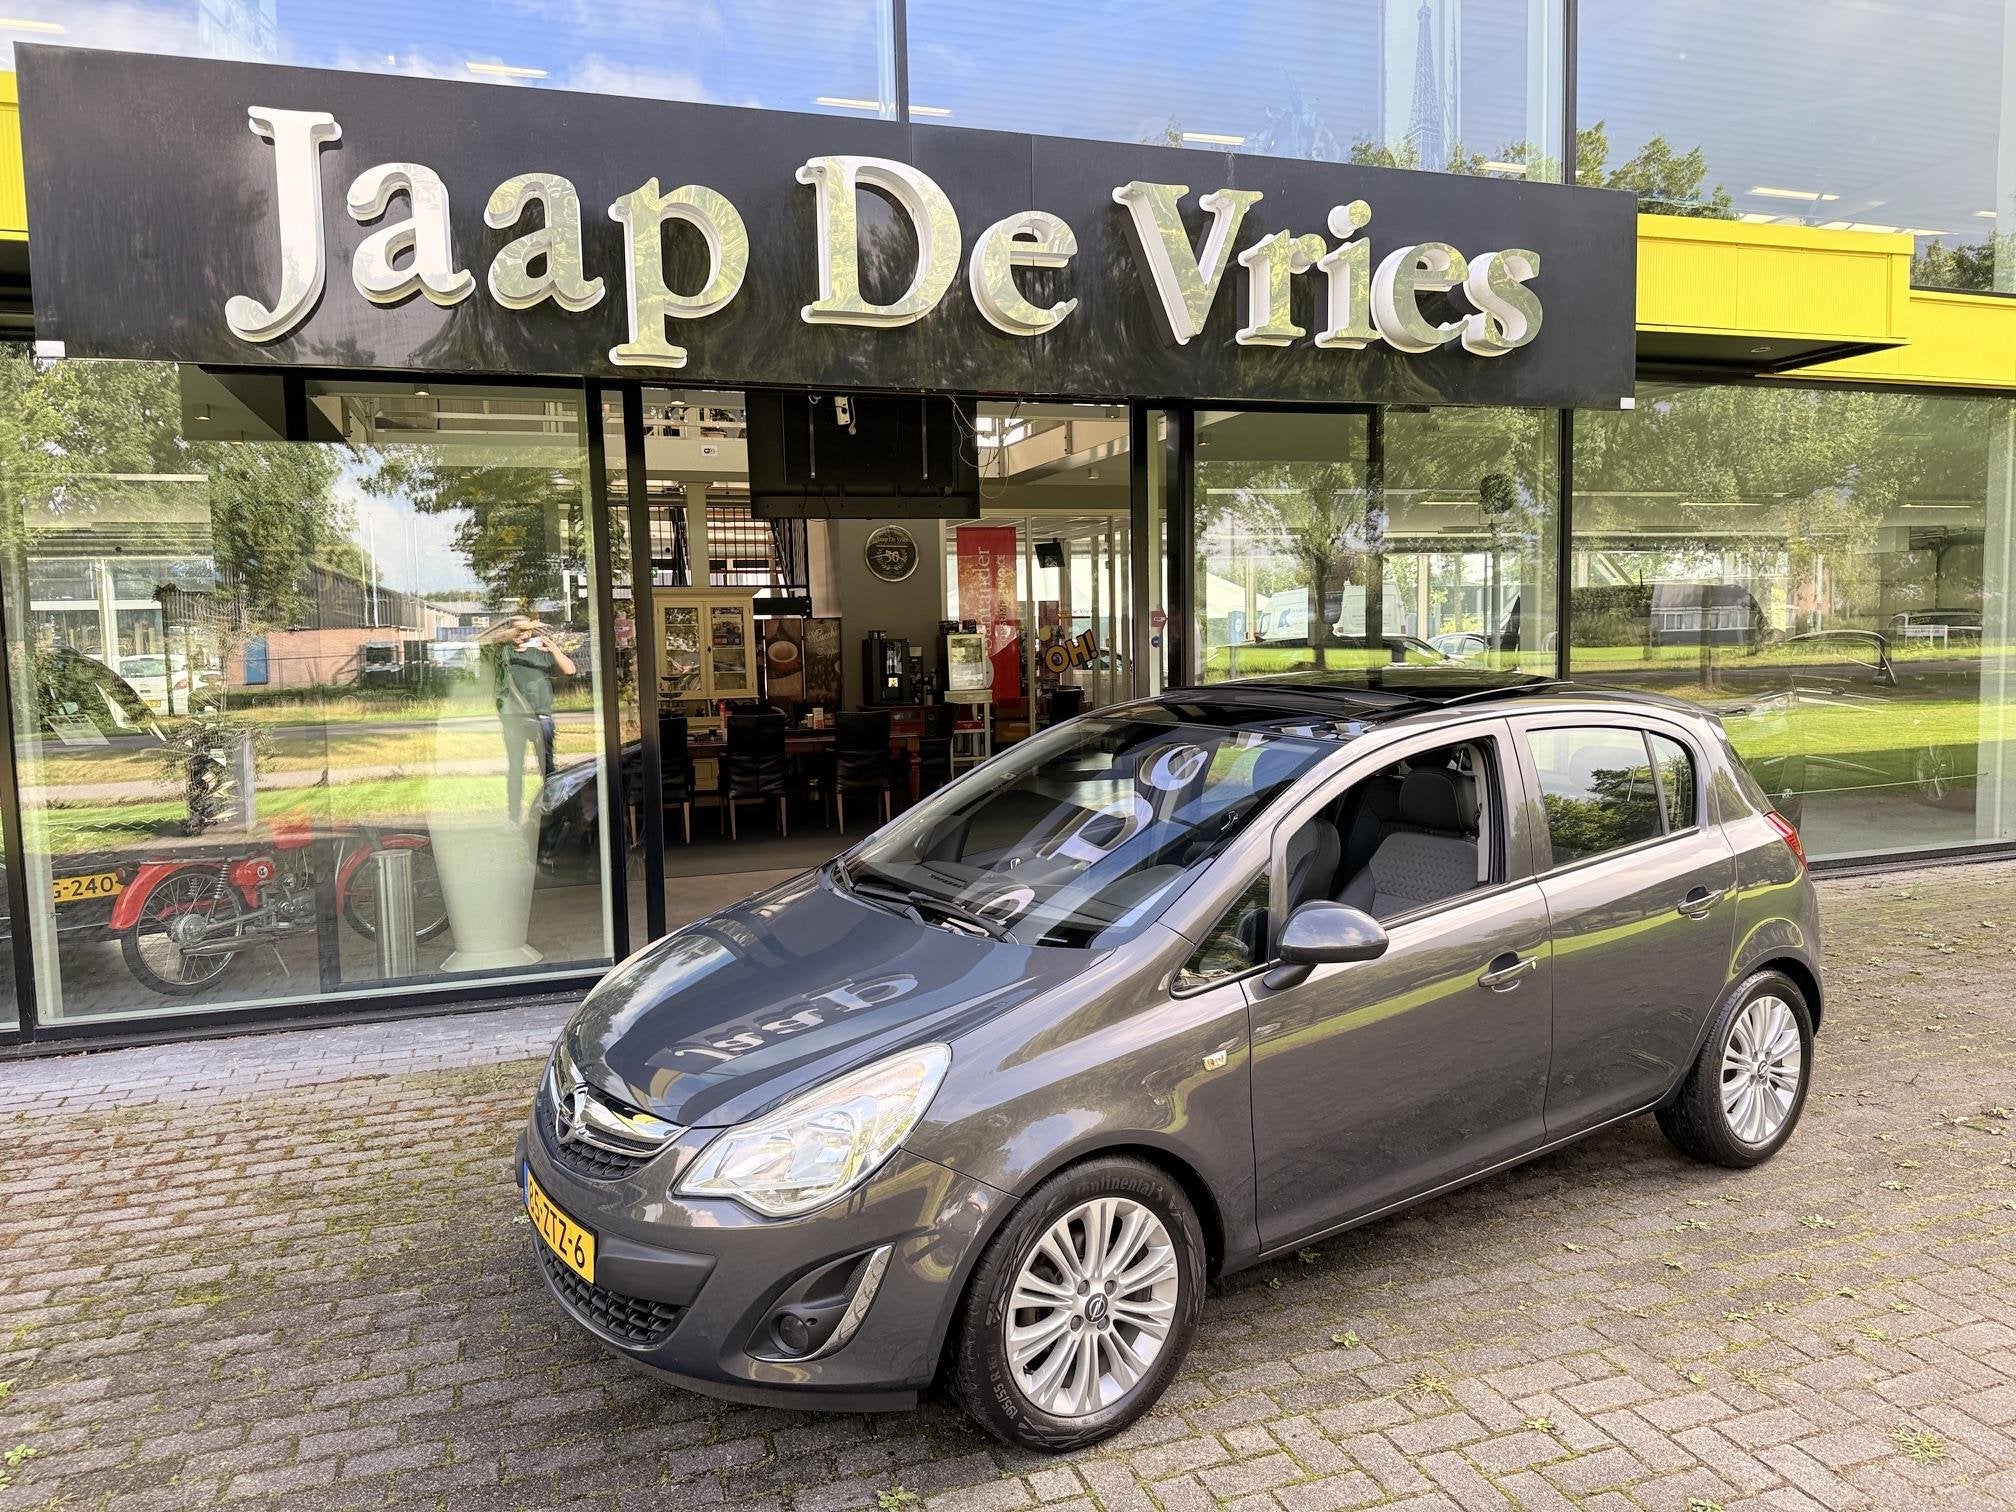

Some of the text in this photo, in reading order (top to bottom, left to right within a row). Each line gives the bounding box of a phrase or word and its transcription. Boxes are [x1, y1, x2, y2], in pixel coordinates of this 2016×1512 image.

[224, 105, 1543, 369] Jaap De Vries
[1045, 629, 1099, 674] OH!
[992, 1382, 1019, 1420] 195/55
